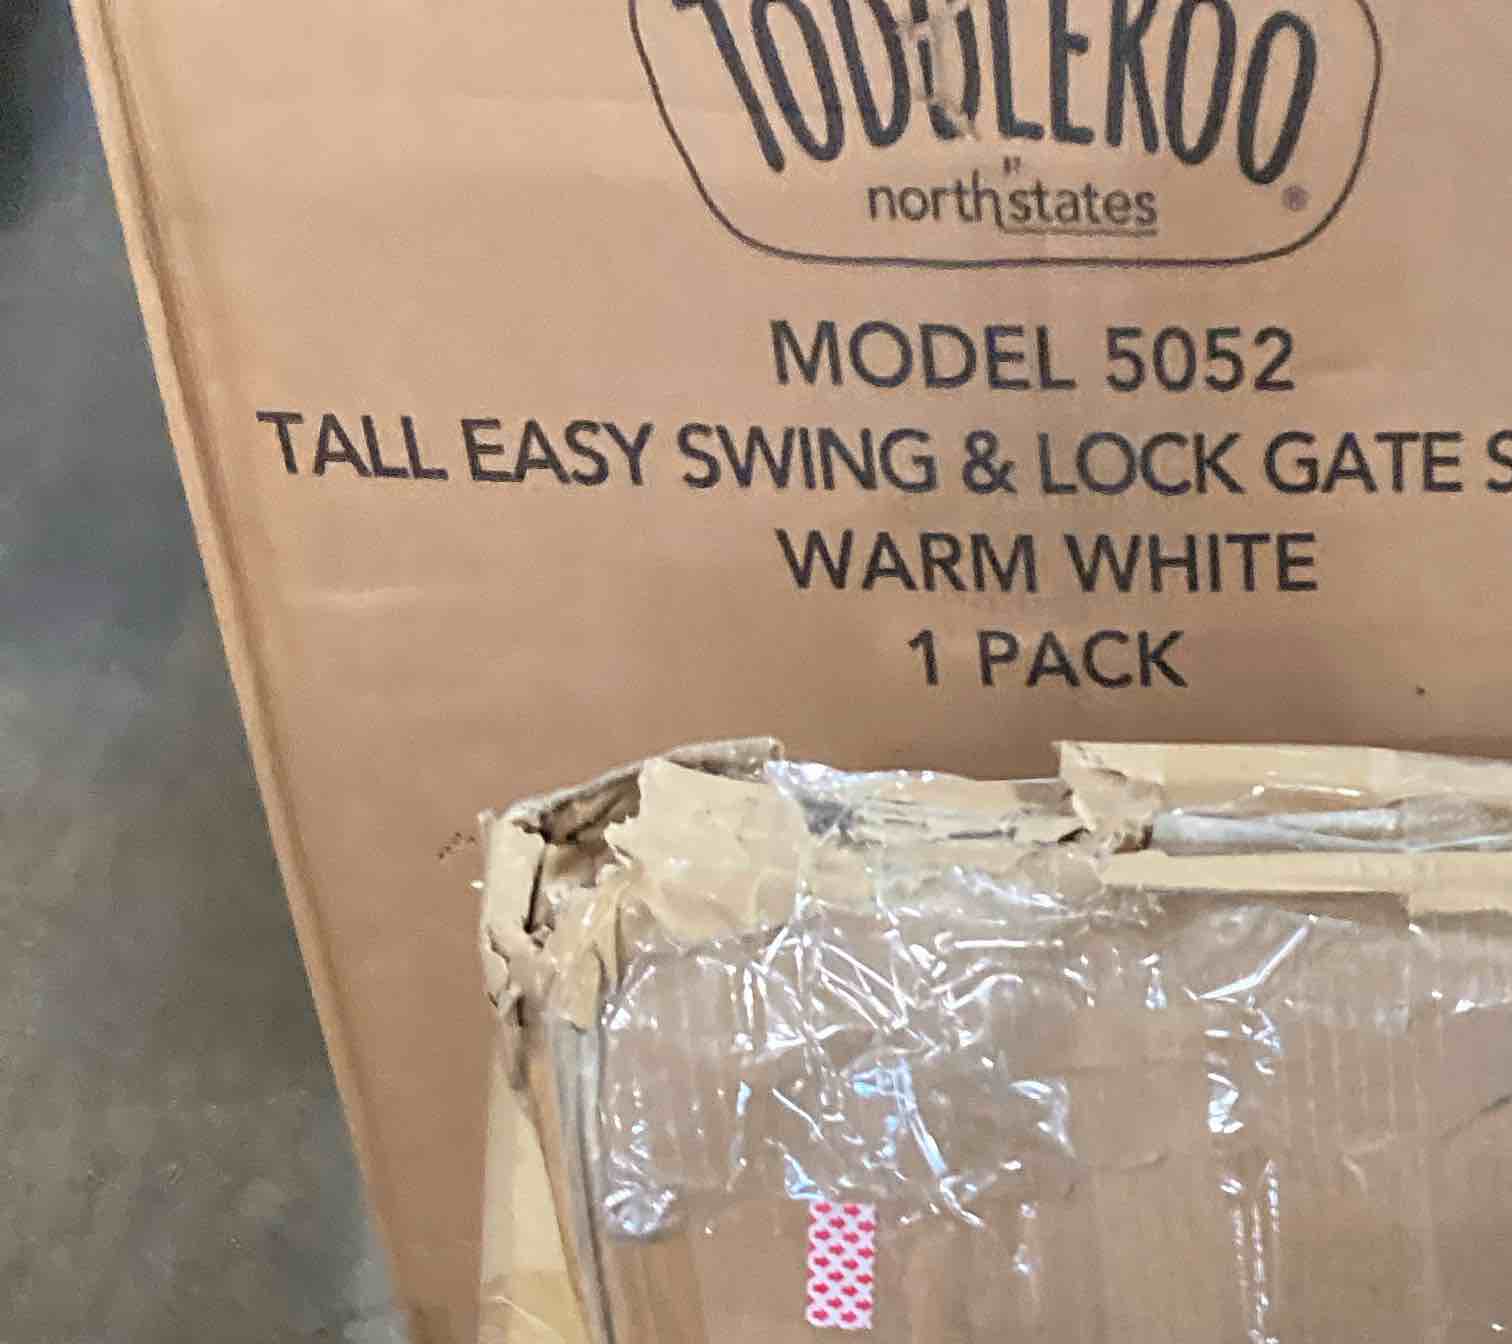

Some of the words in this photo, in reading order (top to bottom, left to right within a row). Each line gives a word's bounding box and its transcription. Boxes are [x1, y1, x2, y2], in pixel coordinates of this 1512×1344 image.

[770, 319, 1077, 391] MODEL
[1107, 326, 1296, 393] 5052
[256, 410, 449, 482] TALL
[460, 418, 654, 487] EASY
[677, 423, 938, 494] SWING
[962, 430, 1017, 495] &
[1038, 431, 1245, 497] LOCK
[1264, 431, 1464, 495] GATE
[775, 528, 1038, 594] WARM
[1064, 533, 1318, 593] WHITE
[909, 630, 939, 686] 1
[979, 631, 1188, 690] PACK
